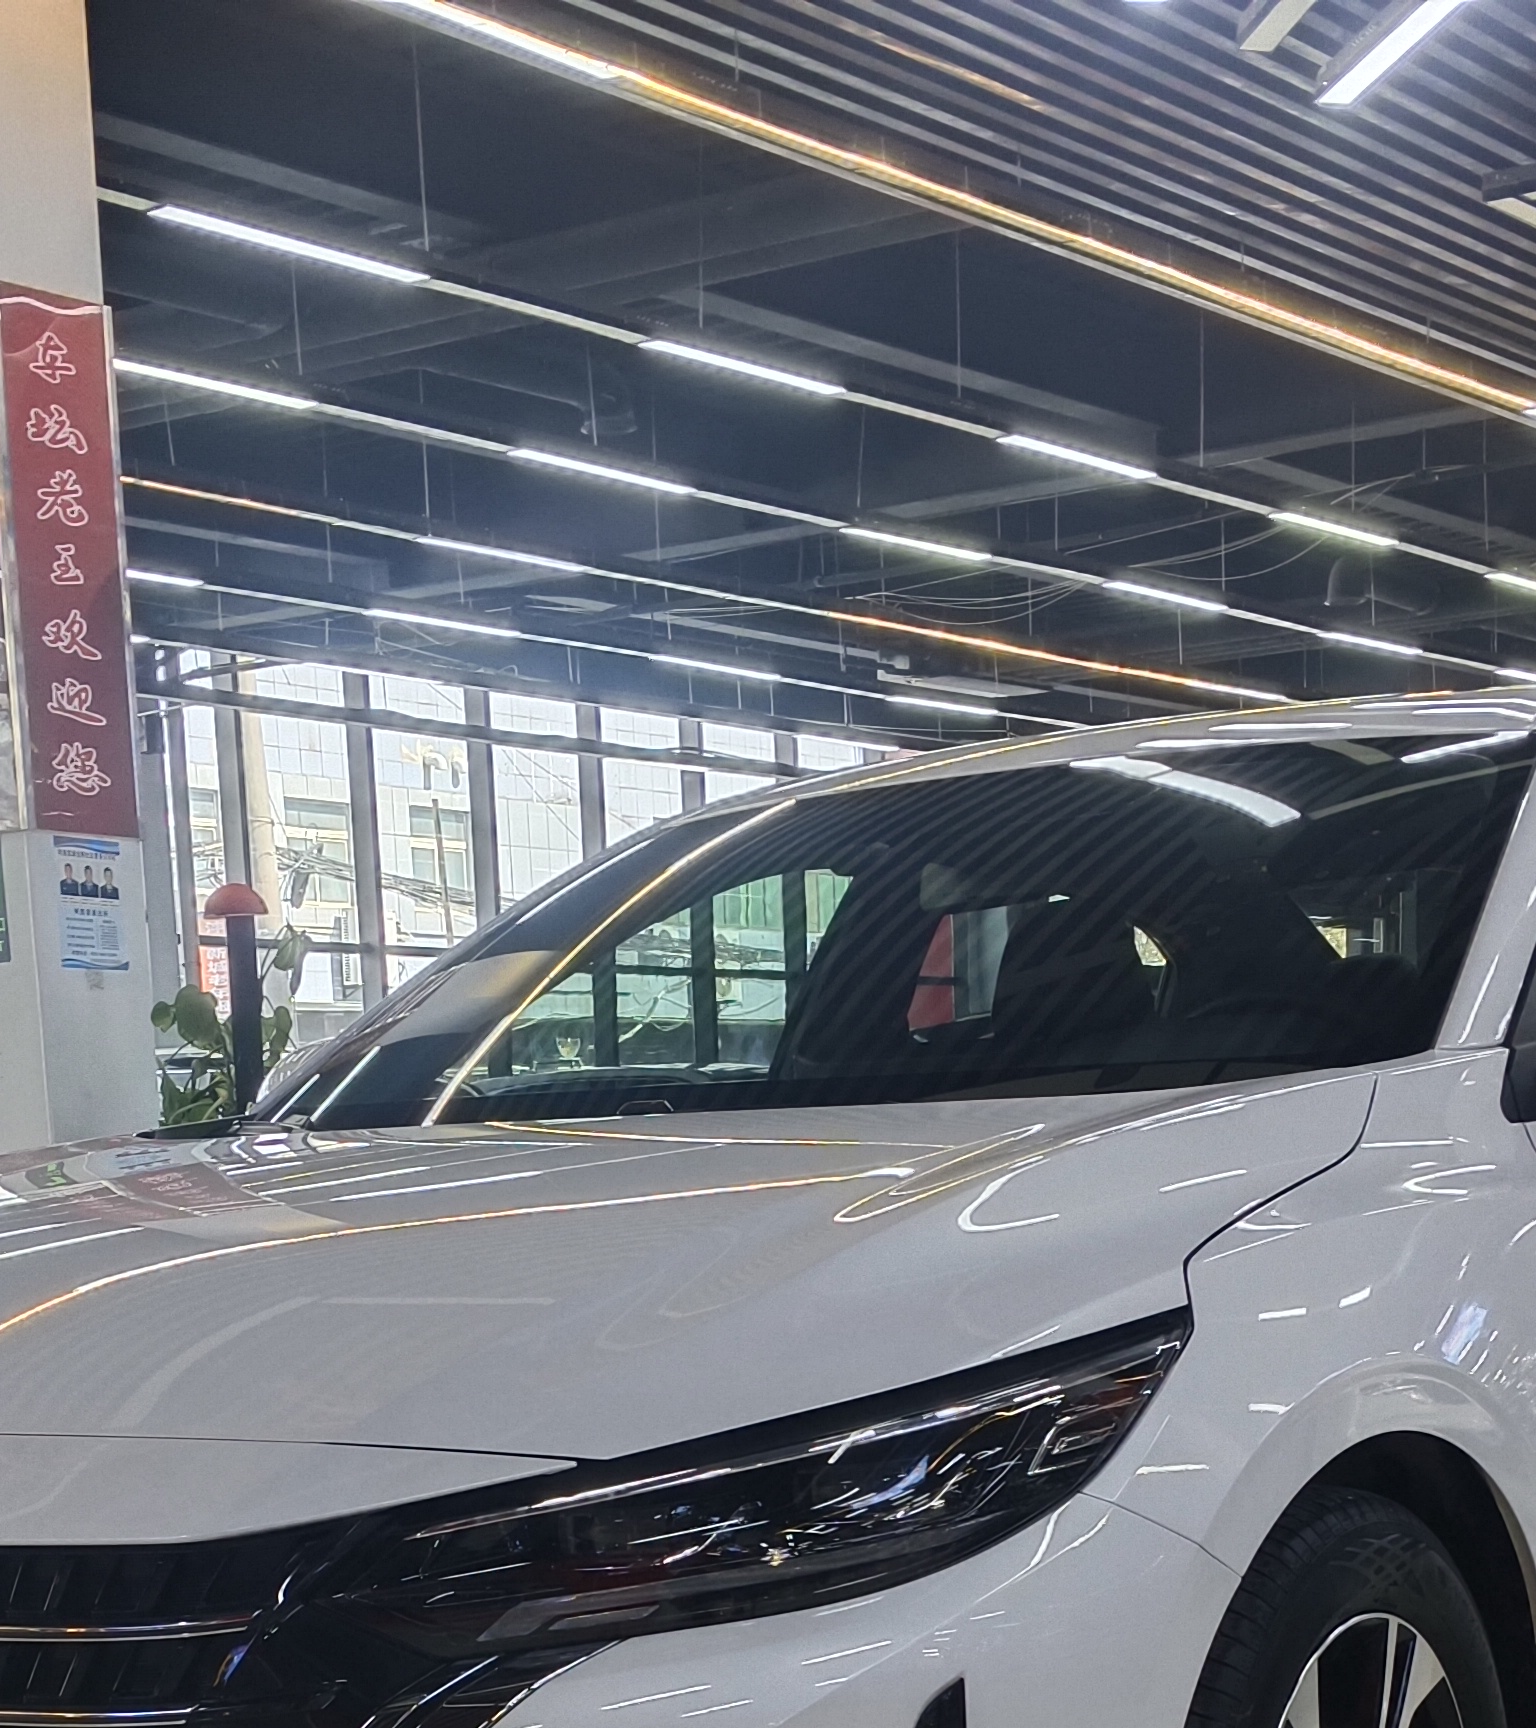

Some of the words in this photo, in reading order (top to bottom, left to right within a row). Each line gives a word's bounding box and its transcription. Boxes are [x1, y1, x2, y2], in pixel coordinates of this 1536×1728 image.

[25, 332, 112, 796] 车坛老王欢迎您
